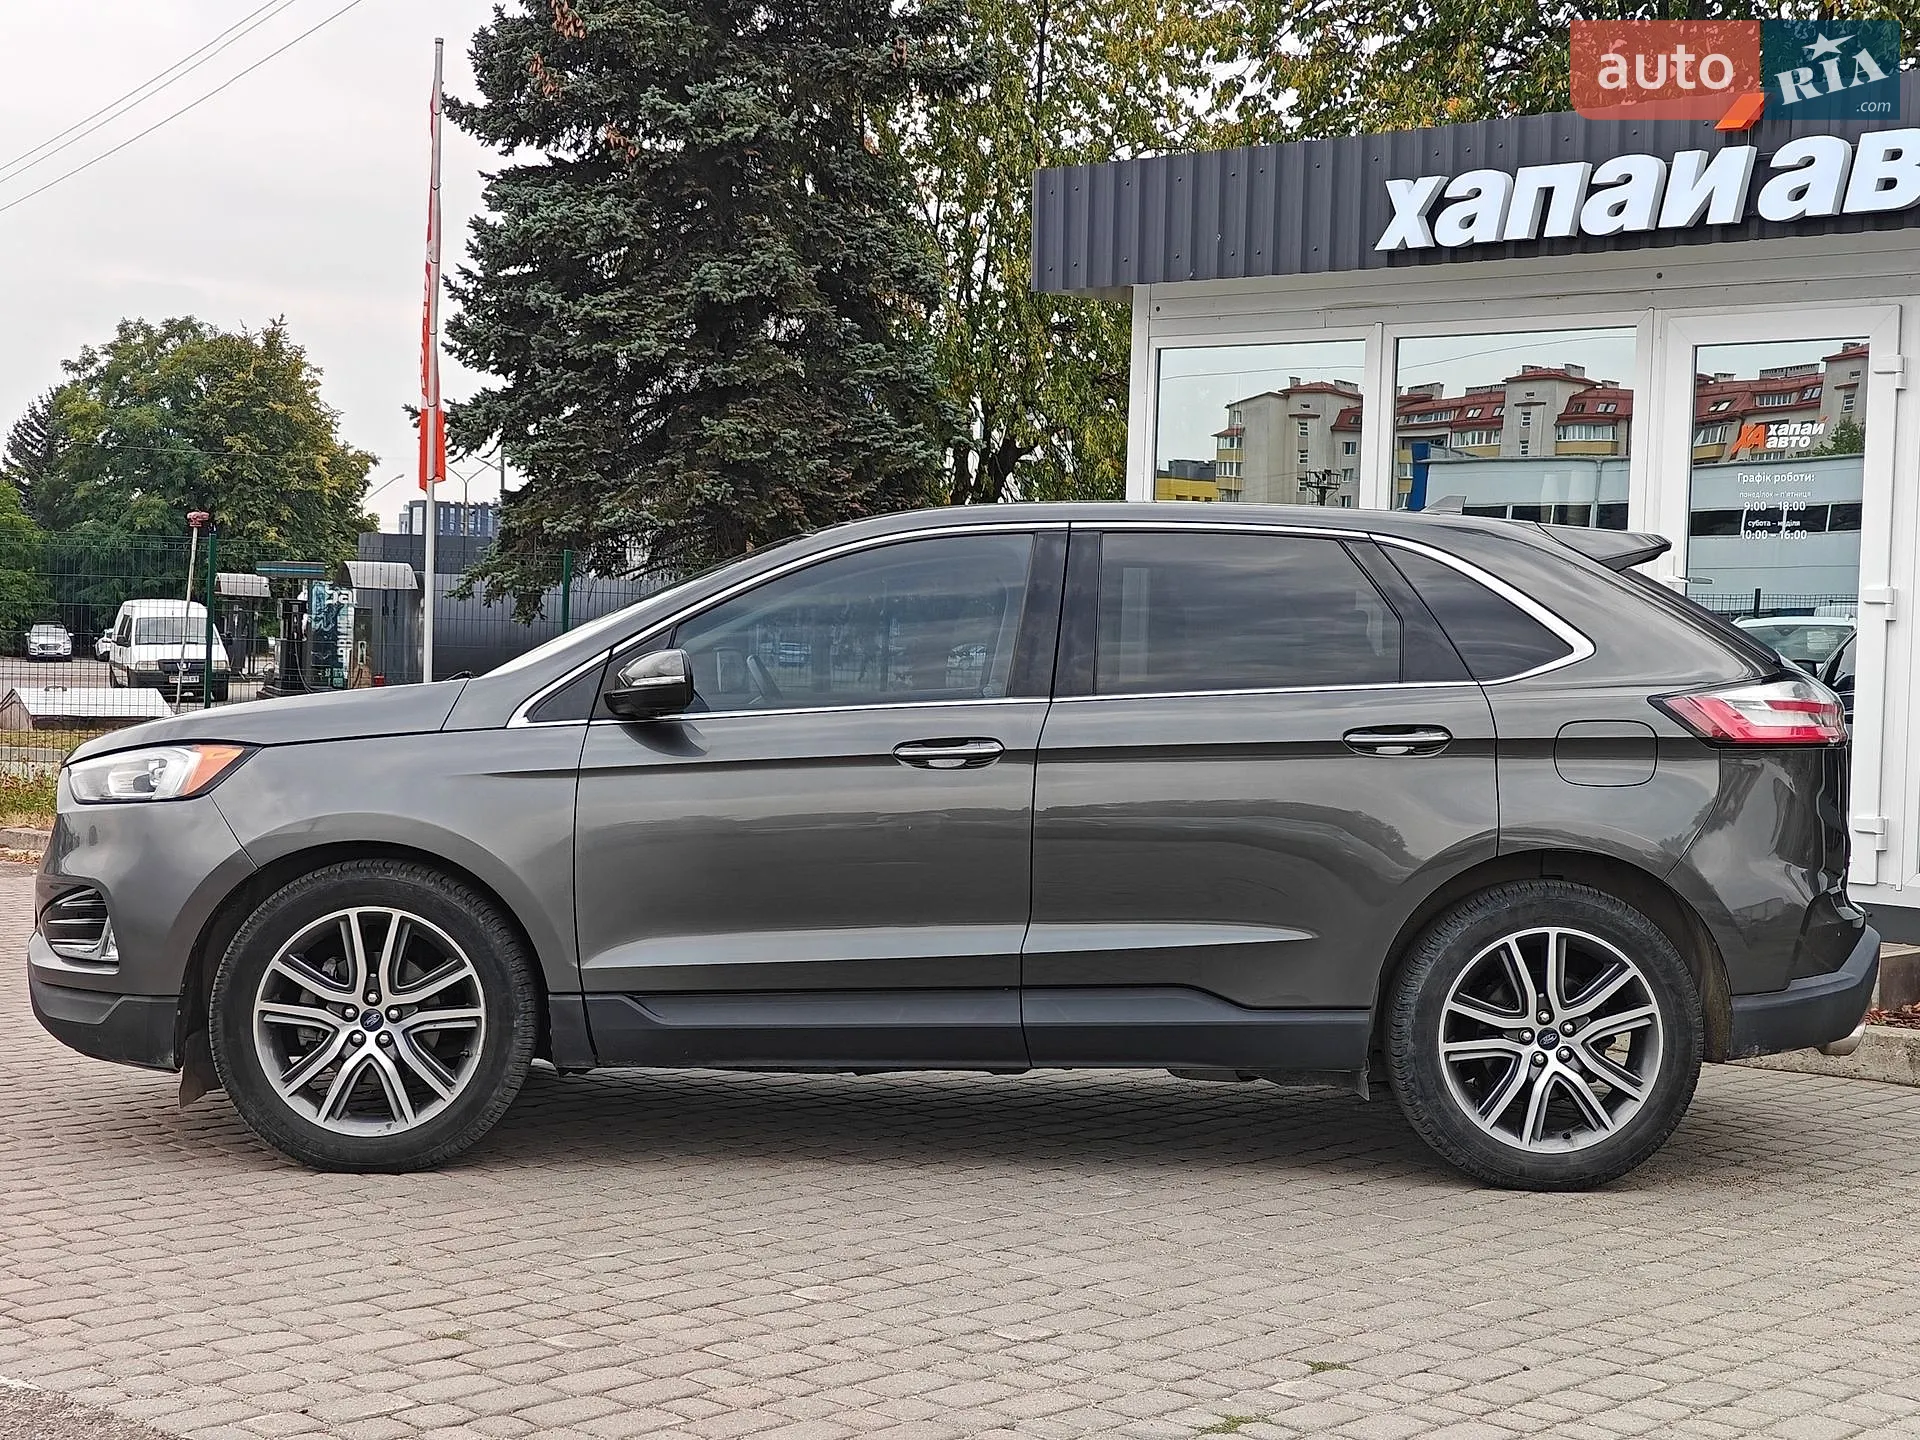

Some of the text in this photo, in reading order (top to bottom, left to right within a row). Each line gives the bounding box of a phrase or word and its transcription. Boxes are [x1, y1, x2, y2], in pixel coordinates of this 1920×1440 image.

[1765, 436, 1811, 449] авто
[1737, 472, 1815, 485] Графік роботи:
[1744, 501, 1767, 511] 9:00
[1778, 500, 1806, 511] 18:00
[1742, 530, 1768, 540] 10:00
[1780, 530, 1807, 540] 16:00
